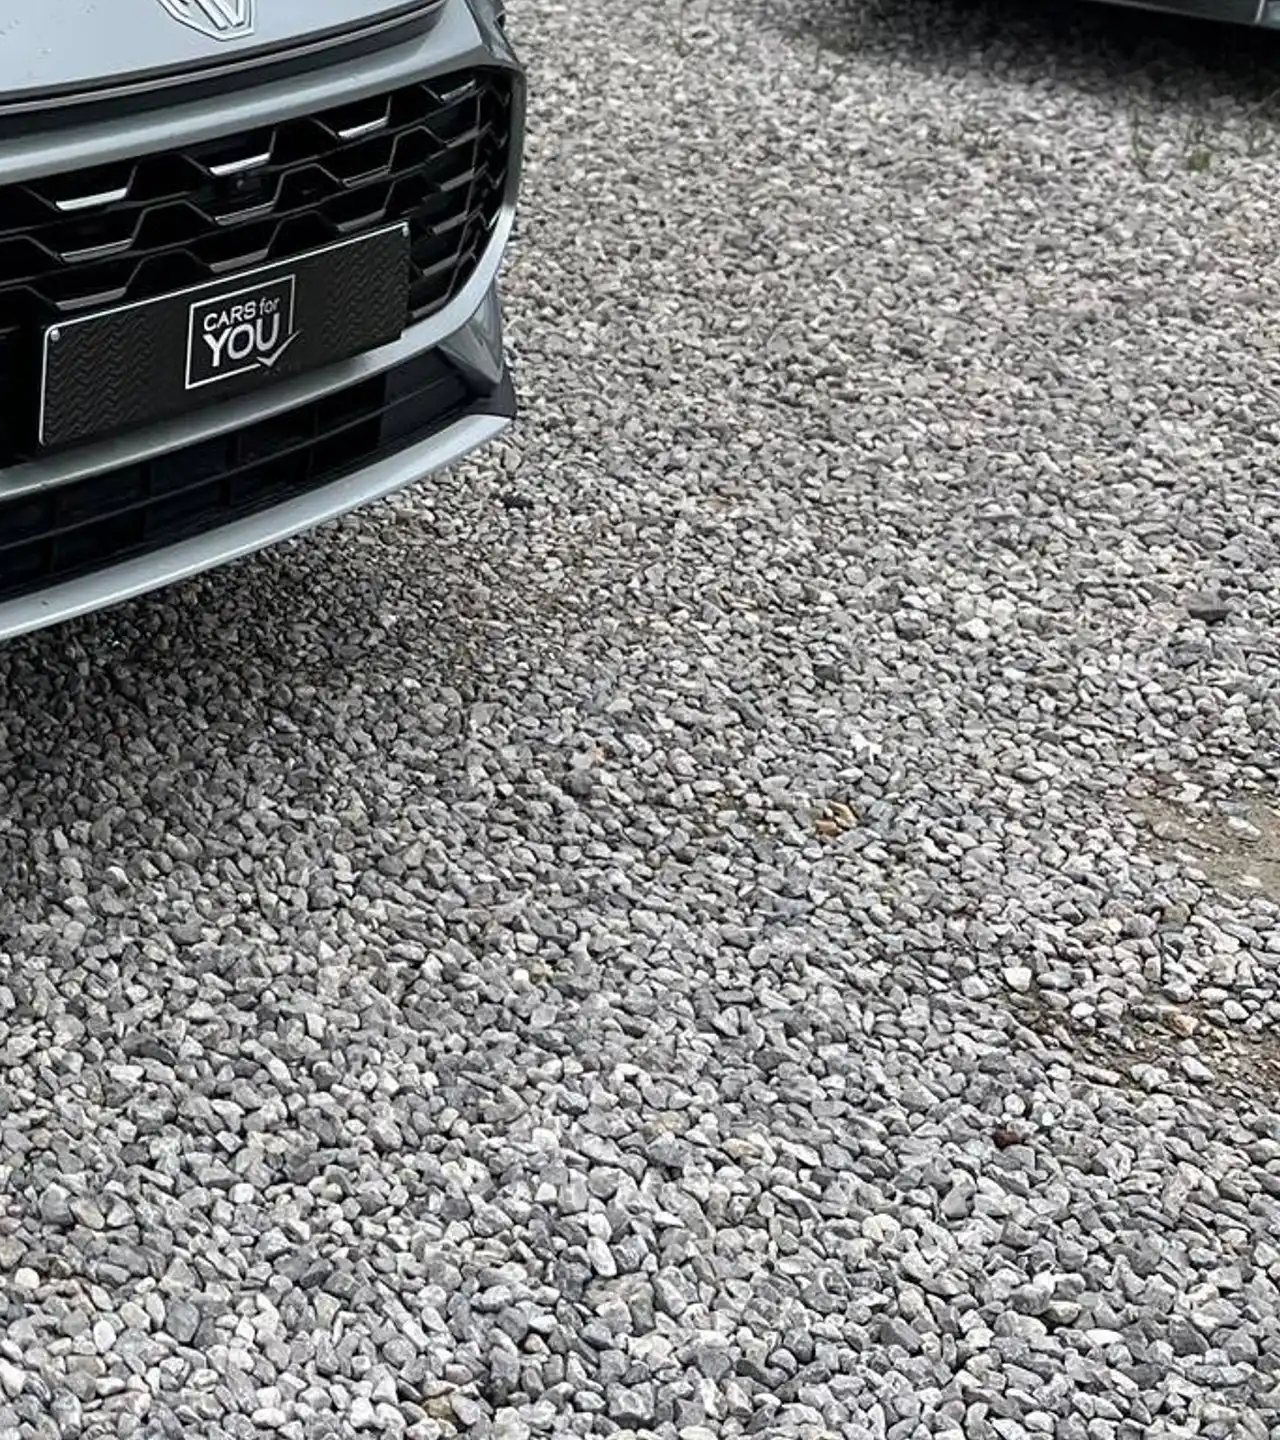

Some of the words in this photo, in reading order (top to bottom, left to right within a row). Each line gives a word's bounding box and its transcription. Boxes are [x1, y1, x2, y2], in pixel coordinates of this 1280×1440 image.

[203, 301, 257, 332] CARS
[259, 296, 281, 315] for
[202, 311, 281, 368] YOU
